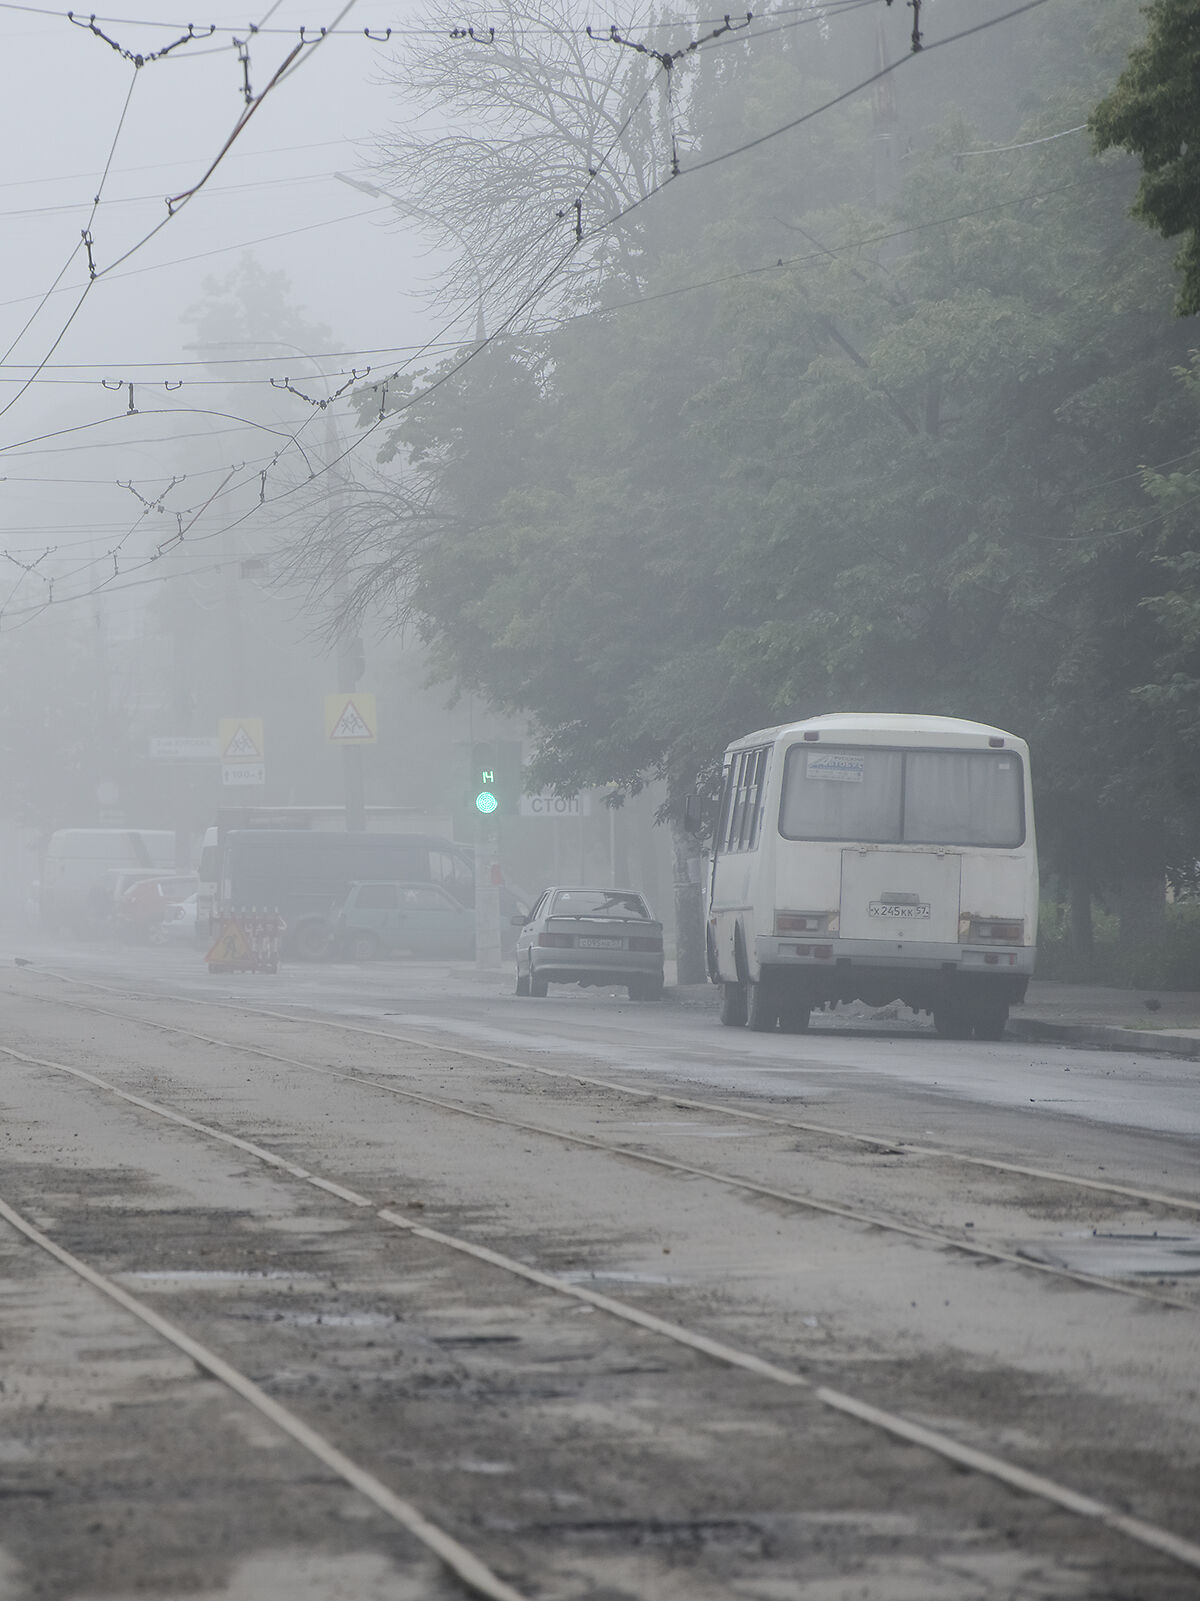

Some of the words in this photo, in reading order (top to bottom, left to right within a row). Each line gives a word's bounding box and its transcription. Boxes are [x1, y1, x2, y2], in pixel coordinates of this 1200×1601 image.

[482, 770, 494, 784] 14
[531, 798, 579, 813] СТОП
[873, 906, 913, 917] Х245КК
[916, 906, 926, 915] 57
